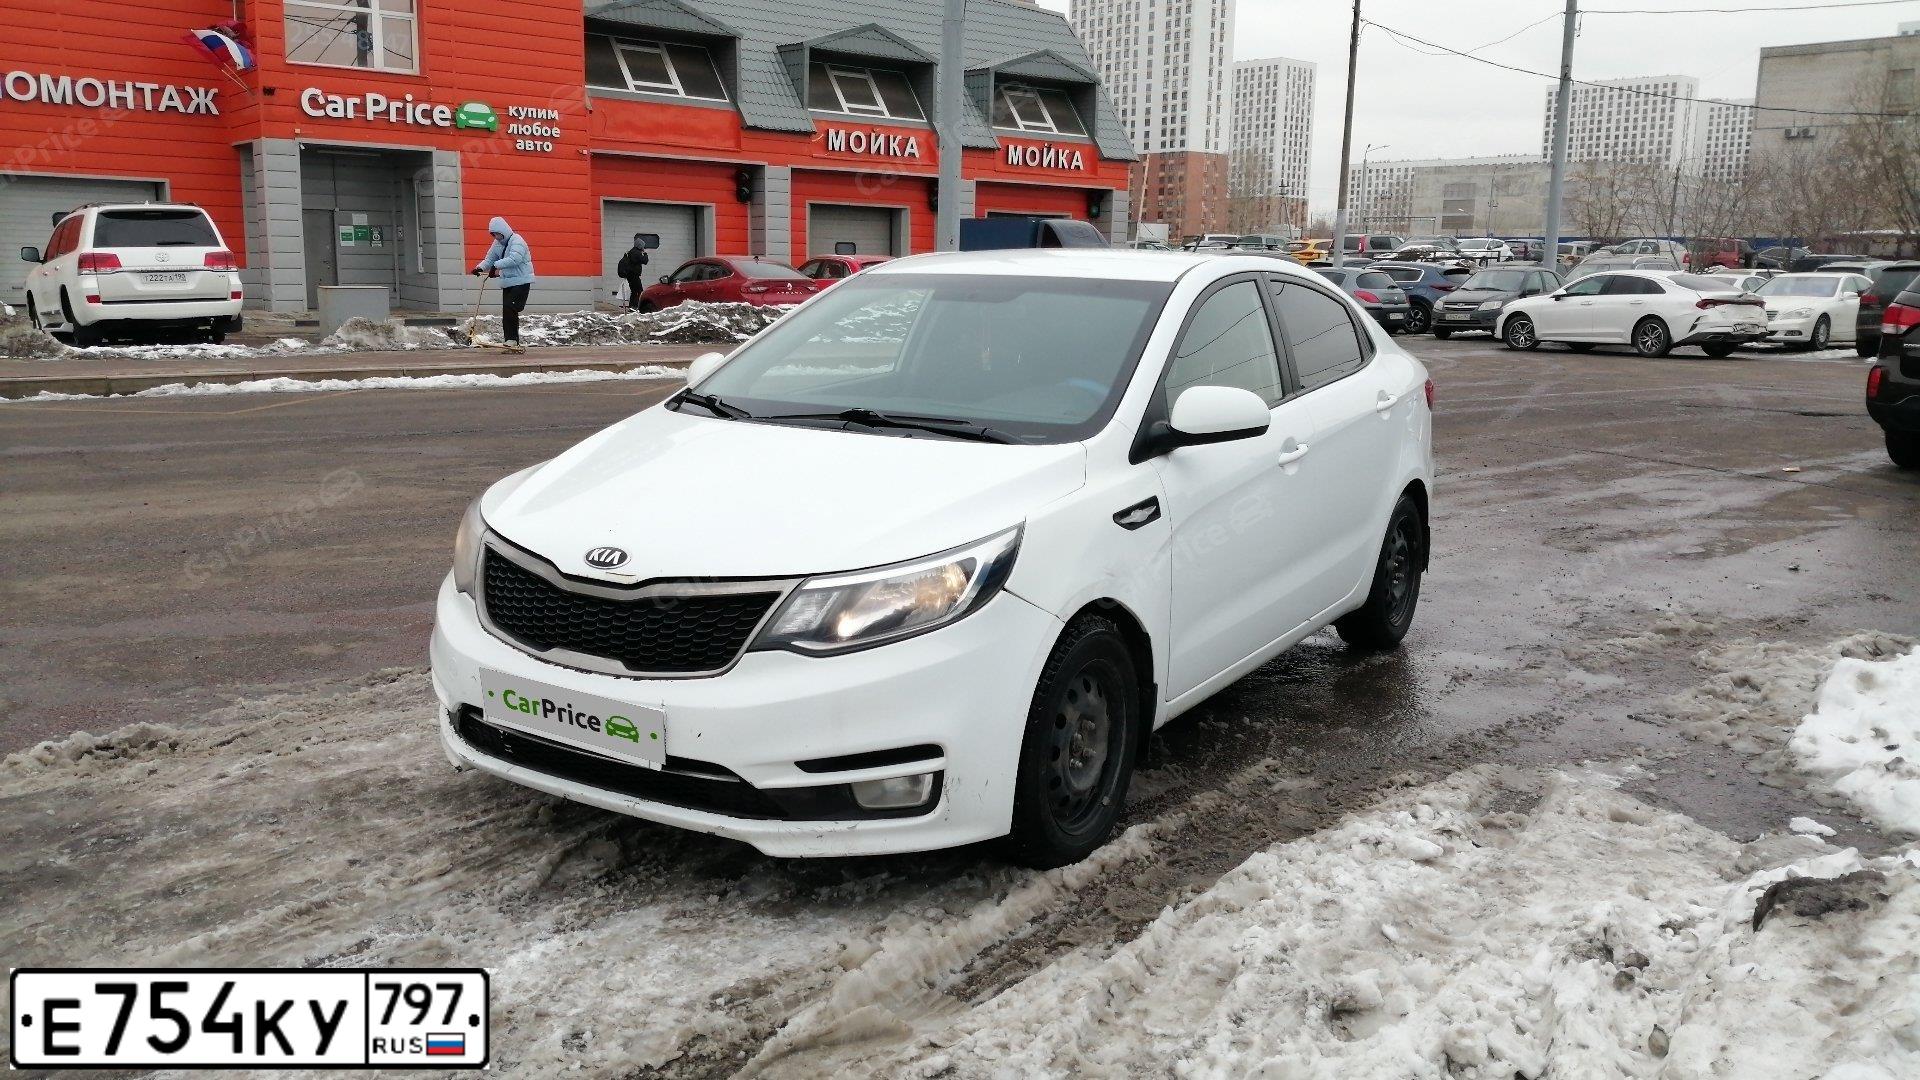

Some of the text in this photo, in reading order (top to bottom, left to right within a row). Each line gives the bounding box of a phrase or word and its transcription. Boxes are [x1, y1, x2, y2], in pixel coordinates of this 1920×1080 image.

[0, 70, 220, 116] ОМОНТАЖ
[507, 104, 560, 121] купим
[506, 121, 562, 138] любое
[515, 137, 554, 153] авто
[827, 127, 921, 159] МОЙКА
[1007, 142, 1085, 172] МОЙКА
[588, 548, 622, 565] KIA
